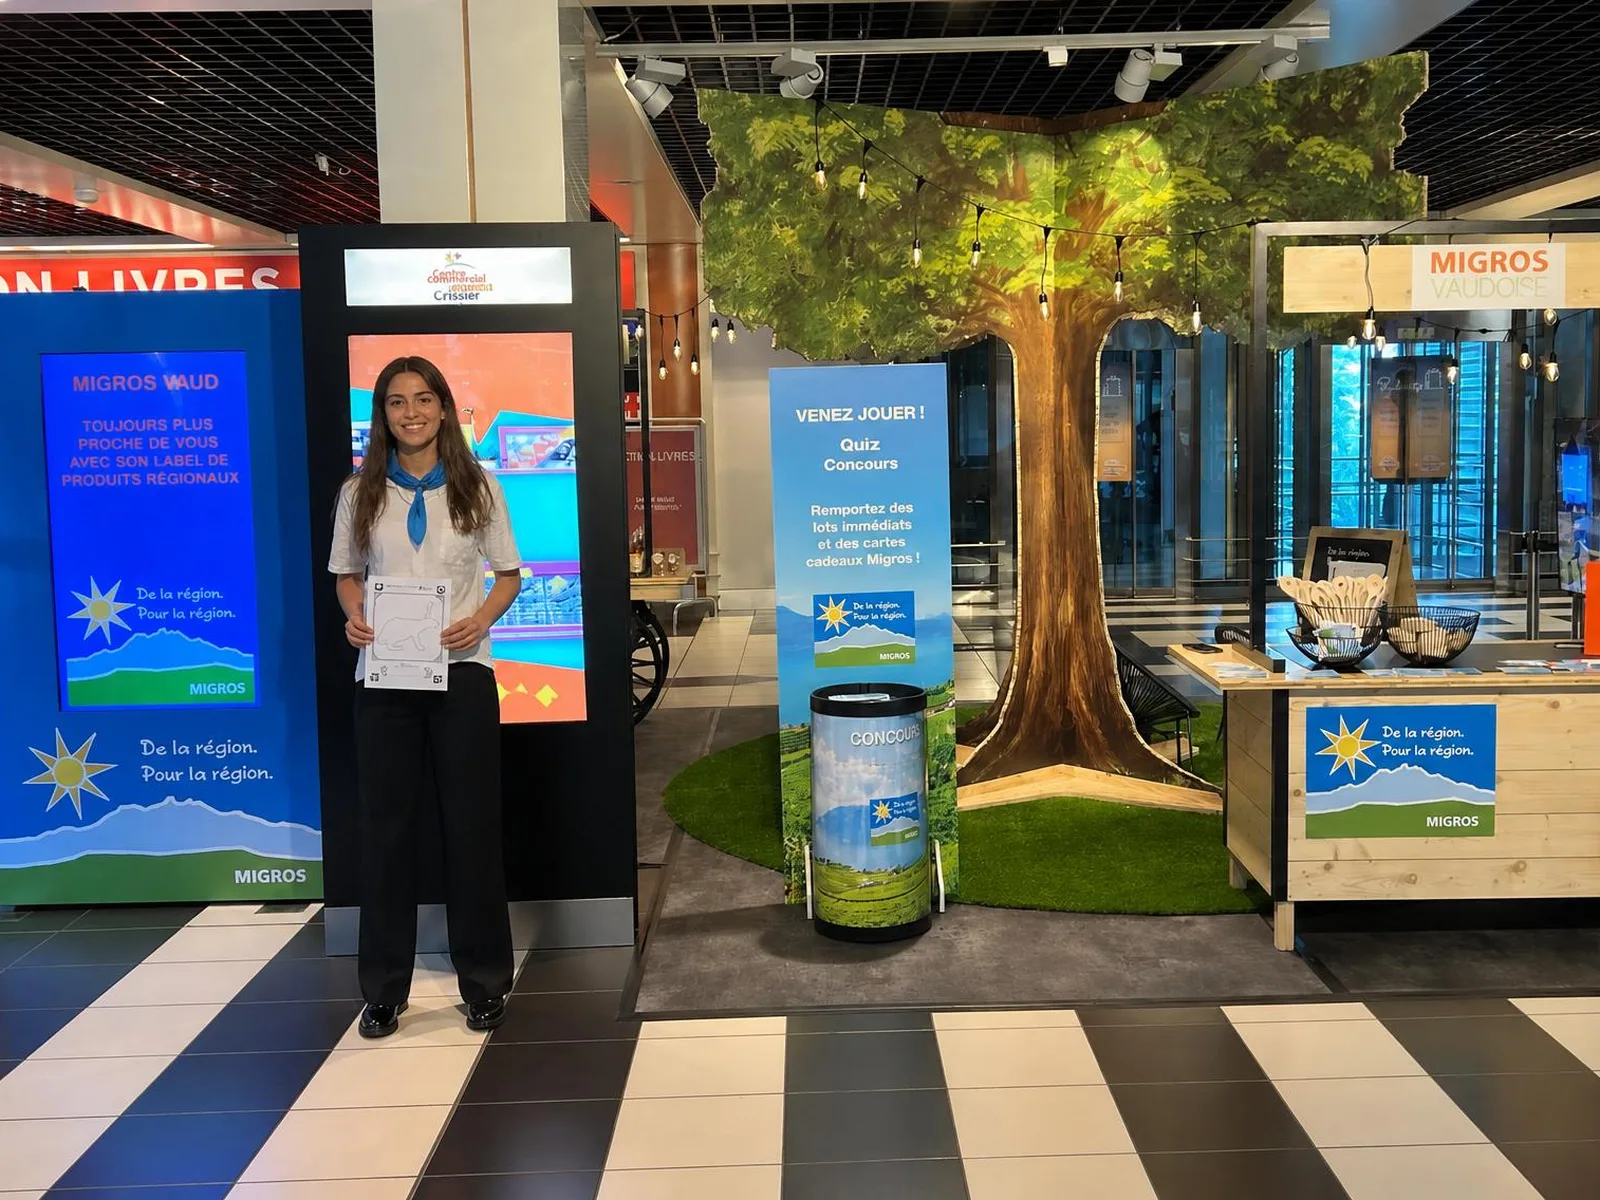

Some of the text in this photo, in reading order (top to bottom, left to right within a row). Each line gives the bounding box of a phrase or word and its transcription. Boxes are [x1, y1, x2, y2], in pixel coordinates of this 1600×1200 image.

[1430, 249, 1549, 274] MIGROS
[433, 290, 480, 301] Crissier
[1430, 276, 1549, 300] VAUDOISE
[73, 374, 219, 391] MIGROS VAUD
[796, 408, 854, 423] VENEZ
[858, 406, 916, 421] JOUER
[82, 418, 213, 432] TOUJOURS PLUS
[78, 436, 219, 450] PROCHE DE VOUS
[840, 437, 881, 452] Quiz
[70, 454, 228, 469] AVEC SON LABEL DE
[657, 450, 695, 462] LIVRES
[824, 458, 898, 471] Concours
[62, 471, 239, 486] PRODUITS RÉGIONAUX
[811, 502, 914, 518] Remportez des
[813, 519, 912, 533] lots immédiats
[818, 537, 906, 550] et des cartes
[806, 555, 863, 567] cadeaux
[867, 553, 913, 567] Migros
[136, 587, 223, 603] De la région.
[137, 605, 236, 622] Pour la région.
[853, 602, 864, 610] De
[871, 612, 879, 620] la
[880, 652, 910, 660] MIGROS
[189, 682, 245, 695] MIGROS
[1382, 726, 1464, 741] De la région.
[140, 738, 258, 758] De la région.
[1382, 744, 1474, 759] Pour la région.
[141, 765, 274, 784] Pour la région.
[1426, 816, 1479, 827] MIGROS
[234, 868, 307, 884] MIGROS
